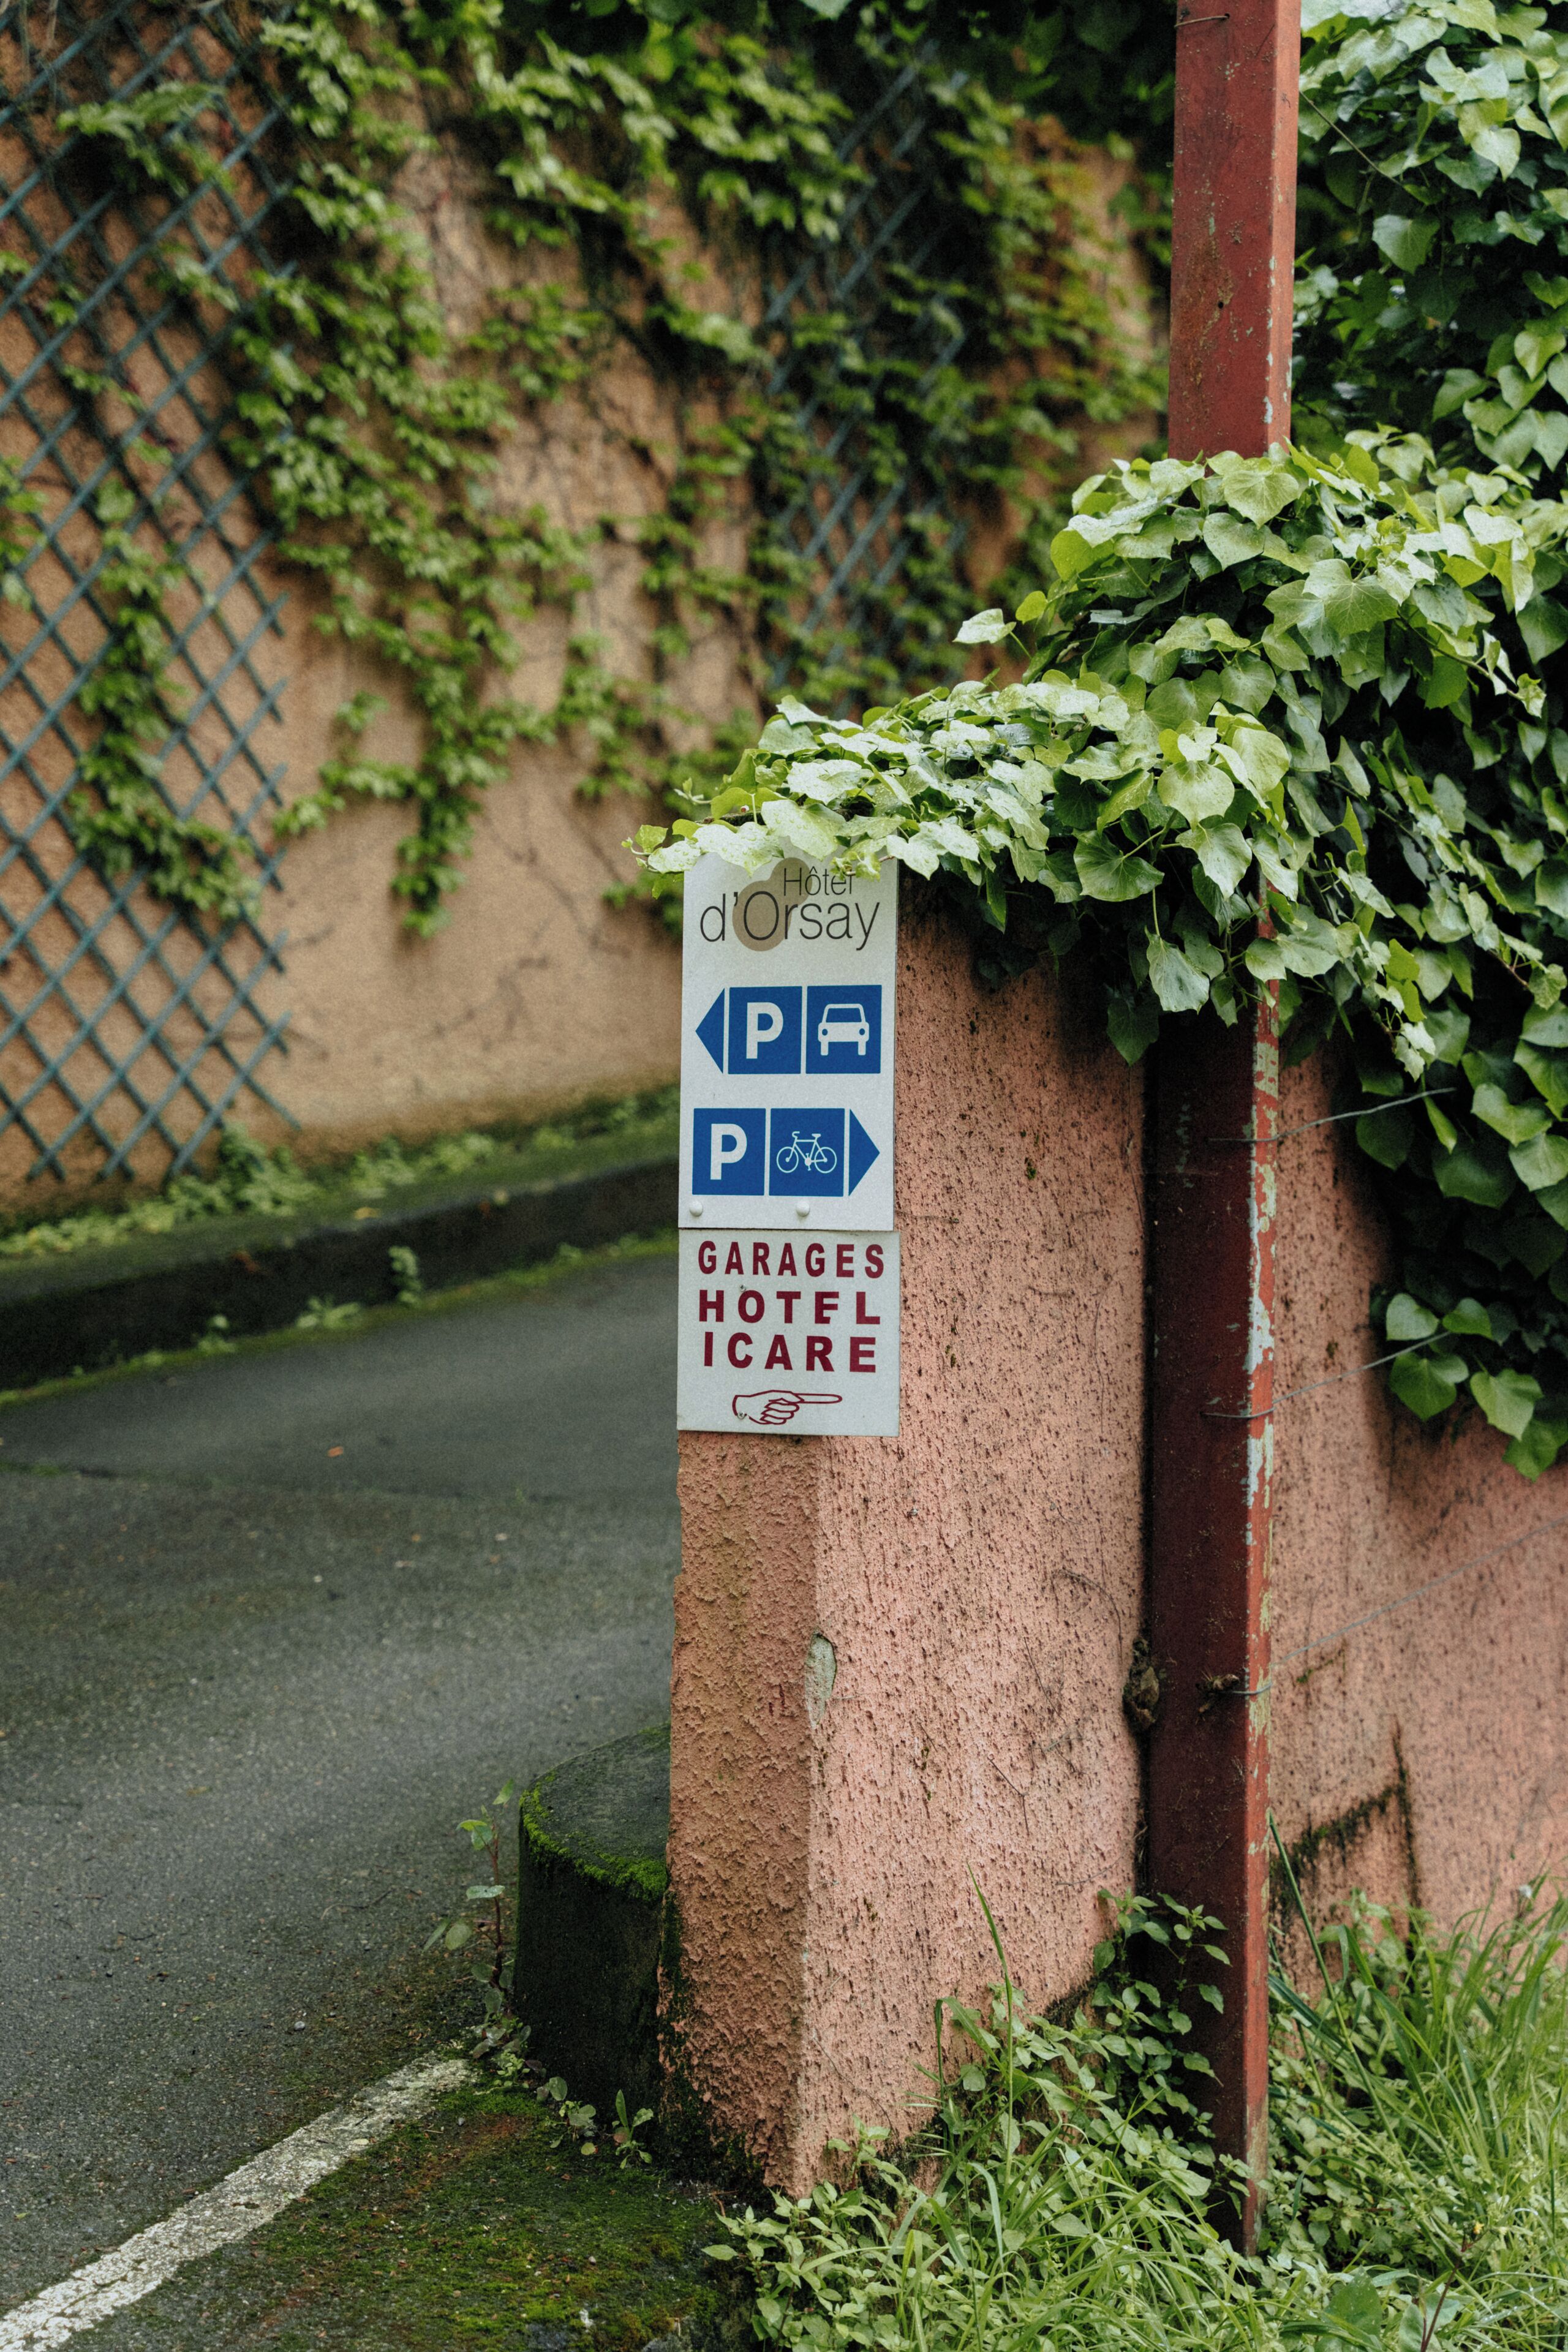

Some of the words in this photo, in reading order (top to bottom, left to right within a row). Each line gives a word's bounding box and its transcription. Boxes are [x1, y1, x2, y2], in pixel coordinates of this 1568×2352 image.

[746, 1002, 783, 1059] P
[710, 1123, 747, 1180] P
[698, 1240, 884, 1279] GARAGES
[699, 1289, 880, 1324] HOTEL
[704, 1332, 876, 1373] ICARE
